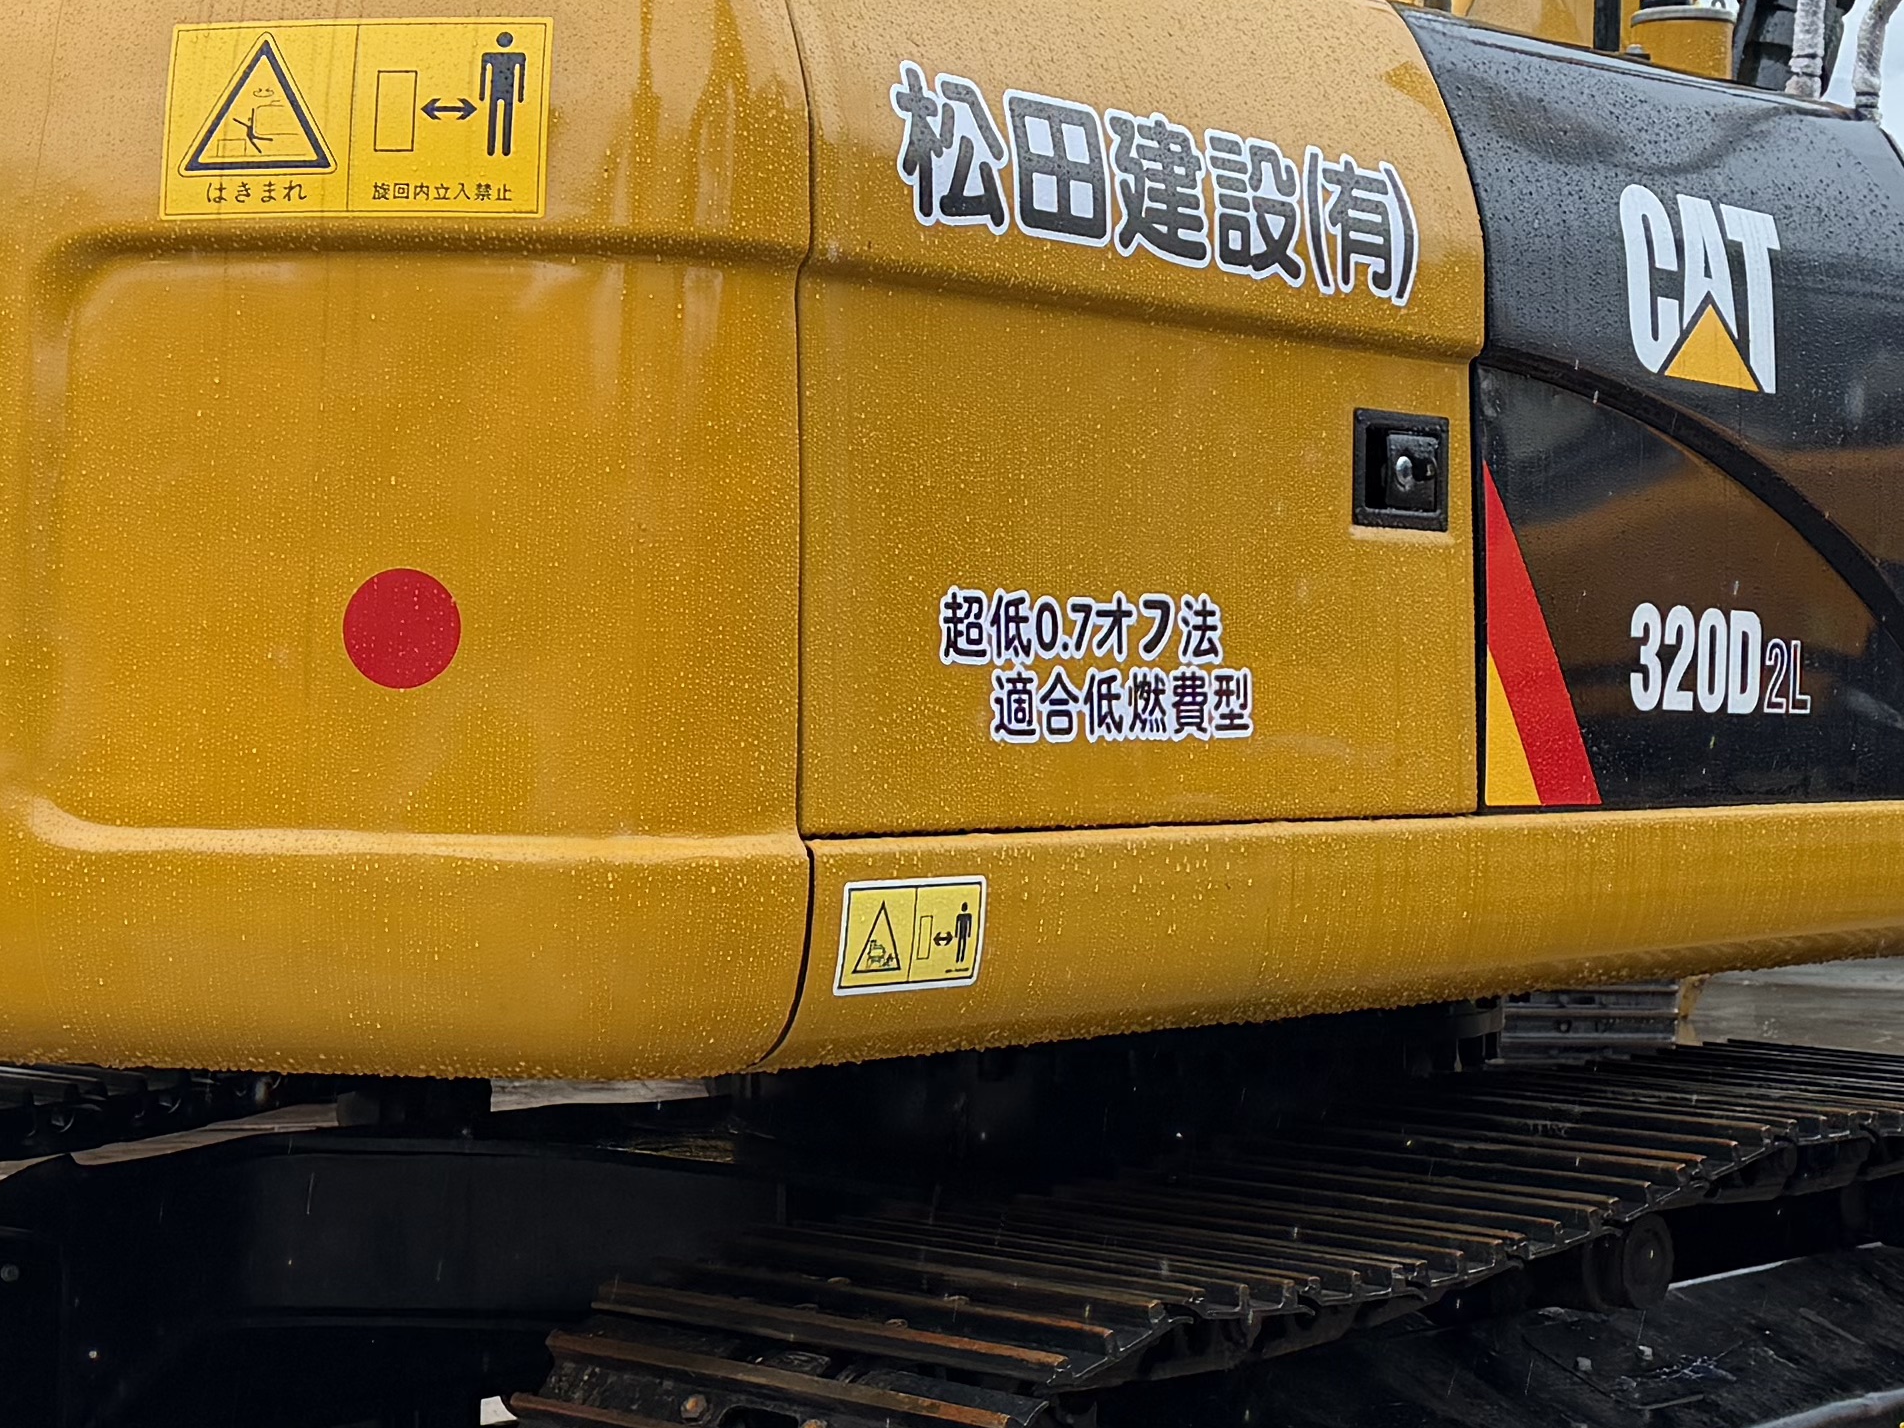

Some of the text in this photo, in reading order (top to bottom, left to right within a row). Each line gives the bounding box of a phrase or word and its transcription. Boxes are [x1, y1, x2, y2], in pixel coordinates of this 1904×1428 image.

[371, 181, 513, 202] 旋回内立入禁止
[891, 61, 1419, 305] 松田建設(有)
[1619, 183, 1782, 393] CAT
[941, 587, 1222, 663] 超低0.7オフ法
[991, 667, 1252, 742] 適合低燃費型
